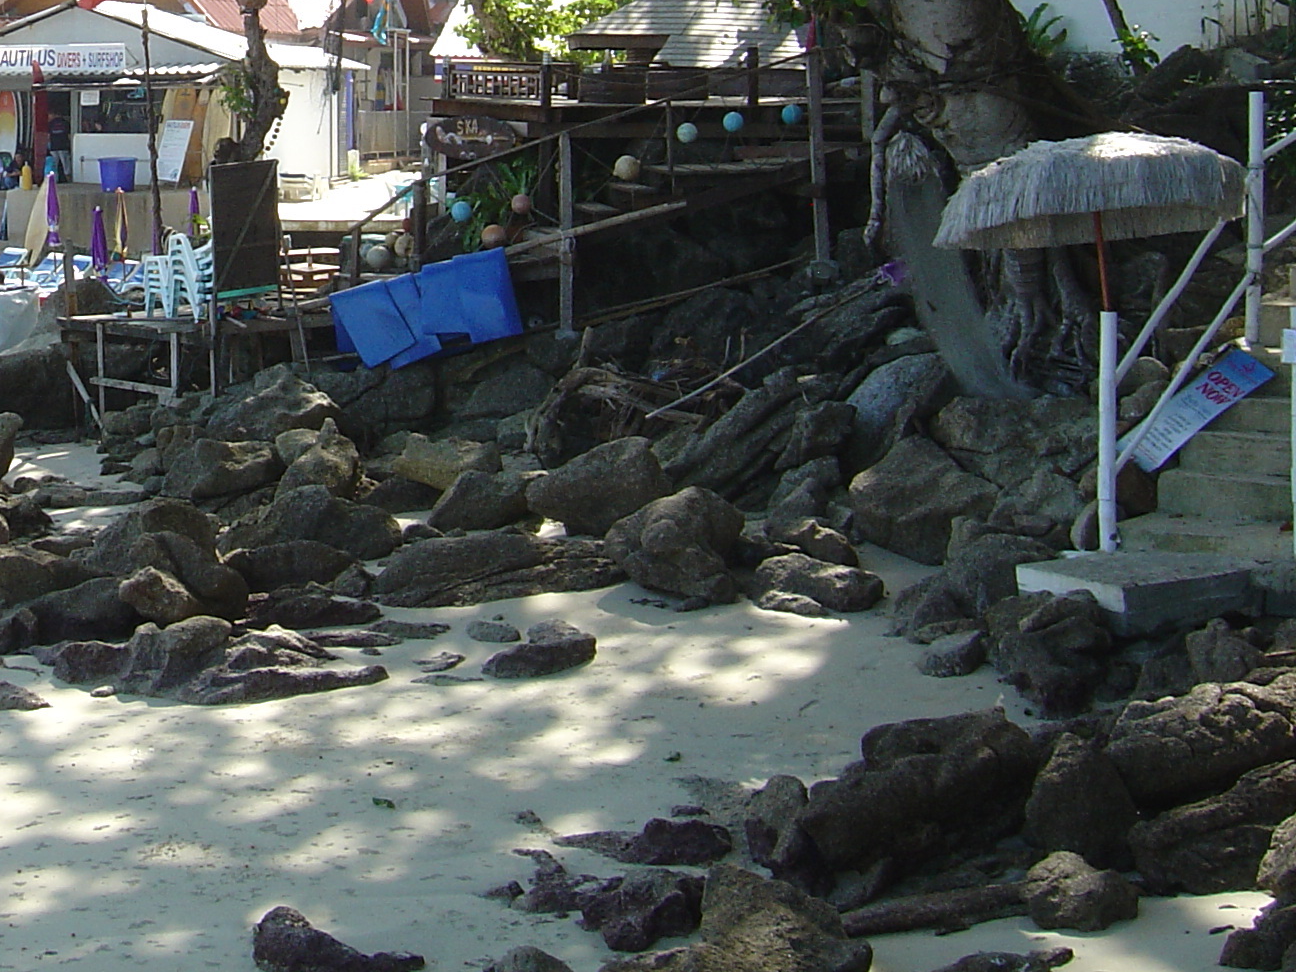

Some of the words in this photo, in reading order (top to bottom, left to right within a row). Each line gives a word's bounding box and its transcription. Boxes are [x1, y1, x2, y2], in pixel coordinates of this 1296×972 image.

[57, 52, 81, 67] DIVERS
[88, 51, 124, 67] SURFSHOP
[1195, 382, 1232, 404] NOW
[1207, 371, 1246, 397] OPEN
